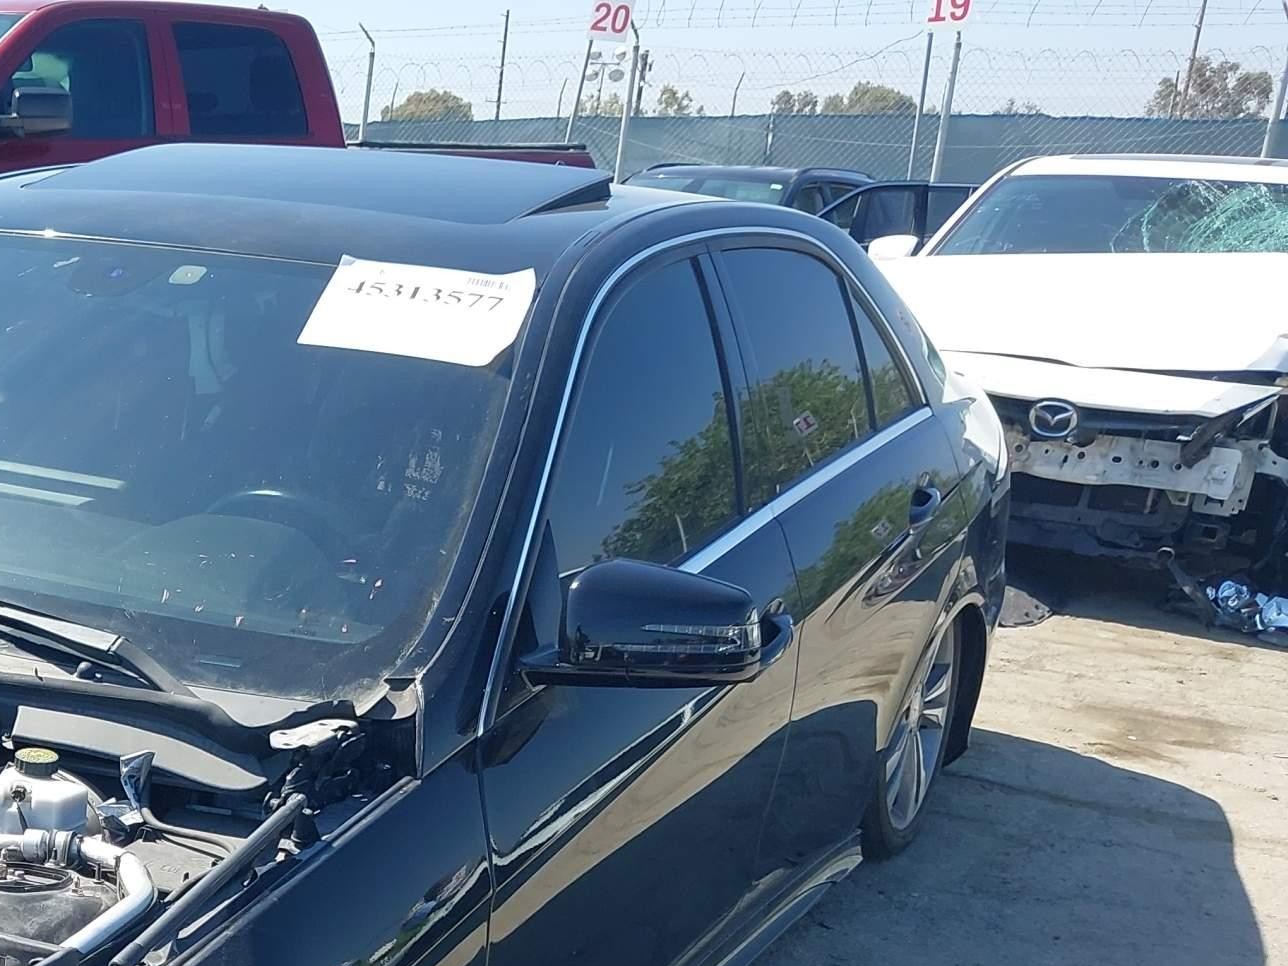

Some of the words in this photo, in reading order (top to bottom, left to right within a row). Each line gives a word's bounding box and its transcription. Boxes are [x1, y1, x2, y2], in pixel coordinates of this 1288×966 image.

[590, 2, 631, 34] 20
[927, 0, 971, 22] 19
[347, 280, 505, 312] 45313577
